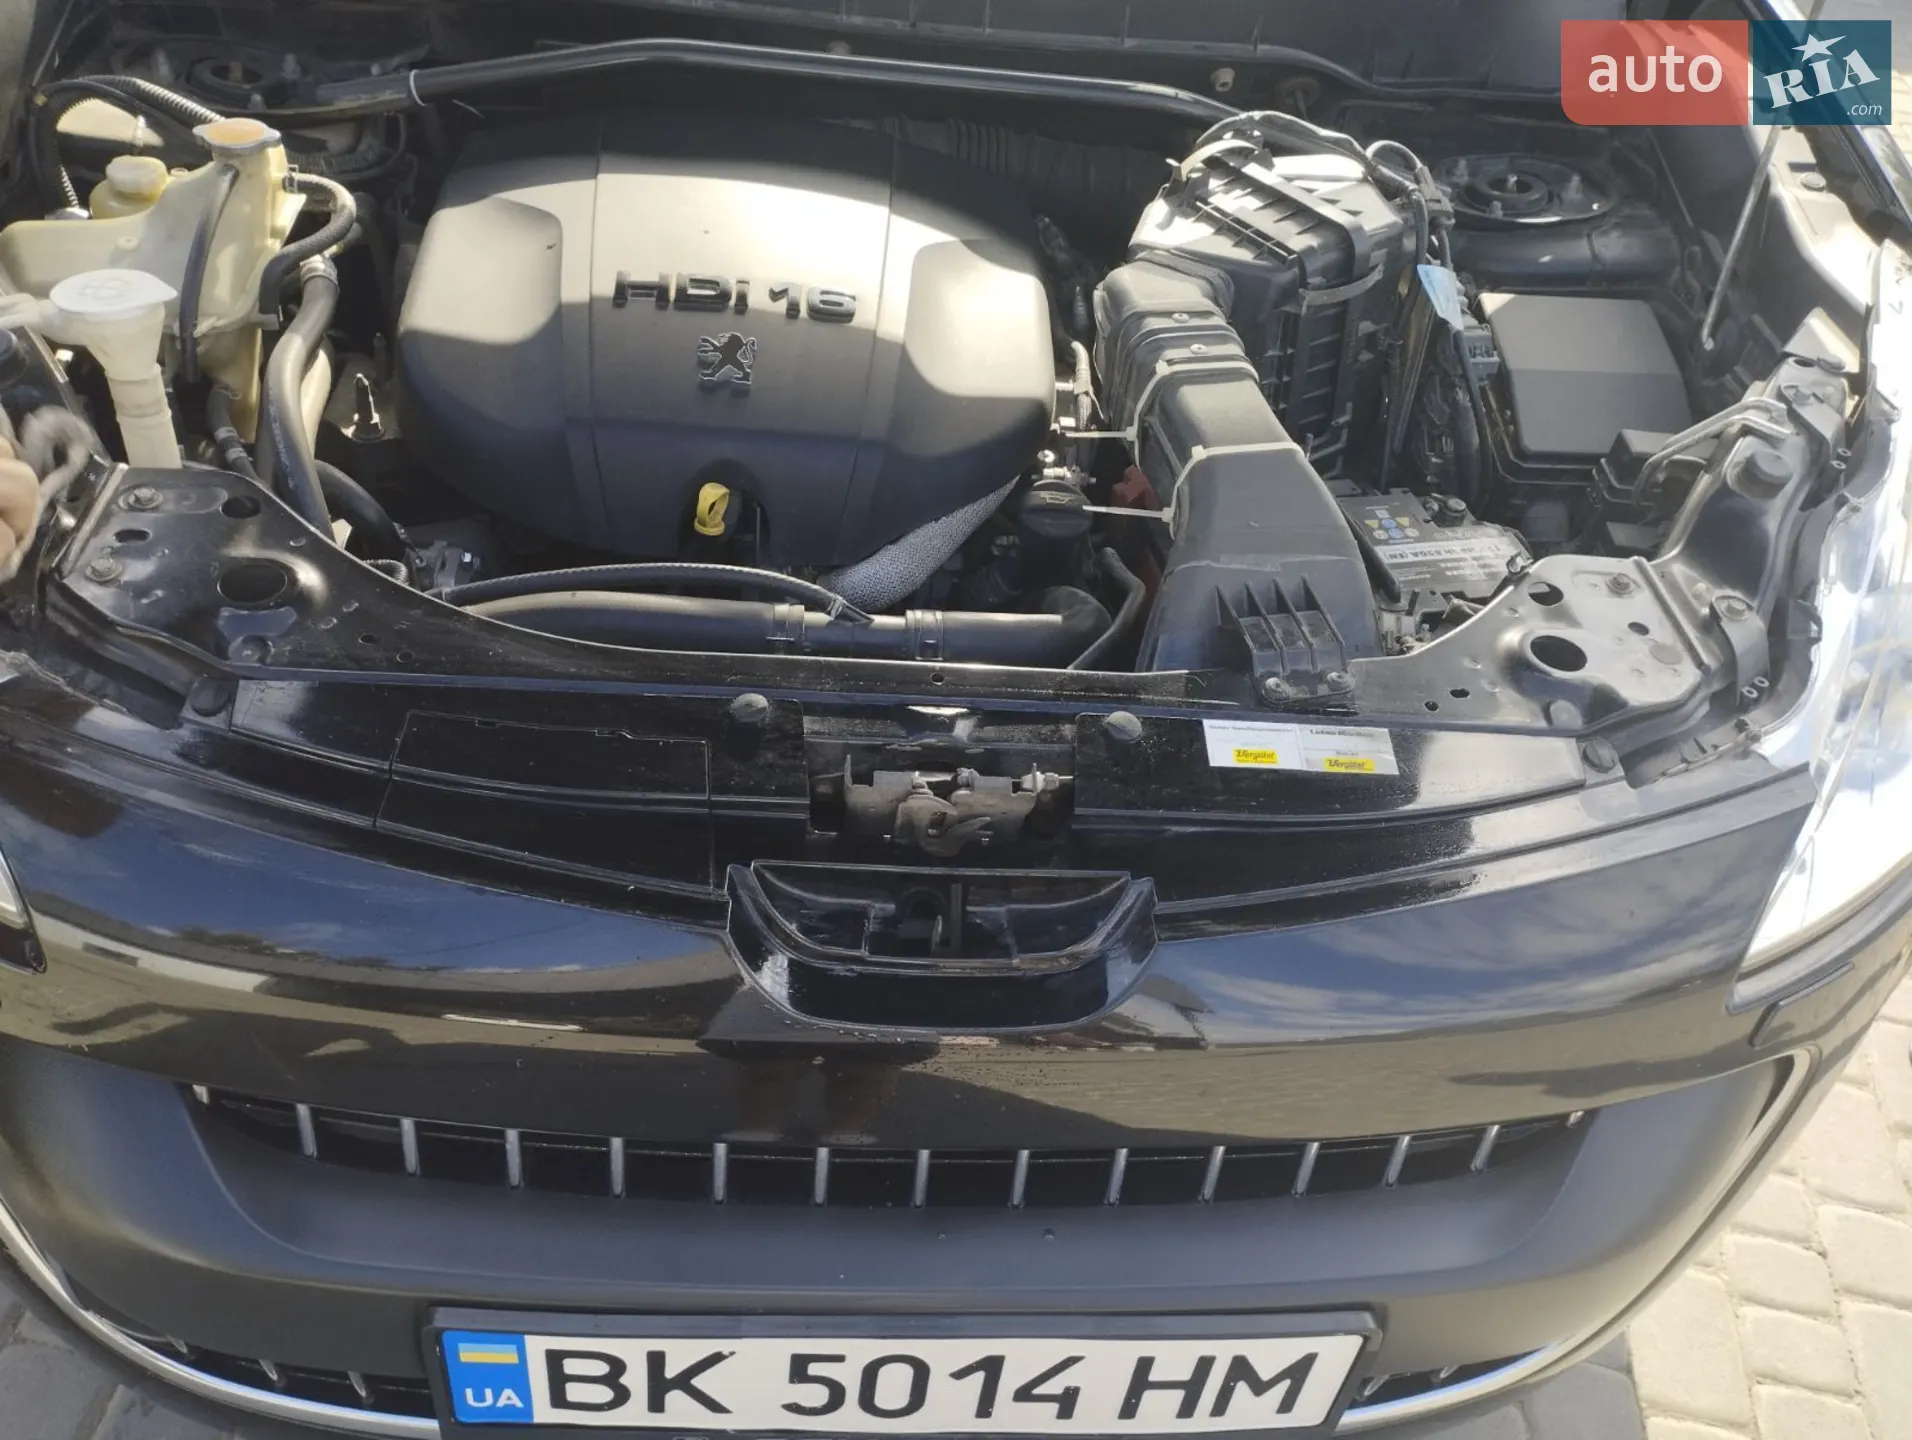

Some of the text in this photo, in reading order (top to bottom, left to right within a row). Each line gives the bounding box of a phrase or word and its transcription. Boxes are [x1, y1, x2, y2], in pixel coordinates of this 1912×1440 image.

[612, 270, 856, 323] HDi 16
[465, 1387, 524, 1408] UA
[545, 1348, 1319, 1420] BK 5014 HM
